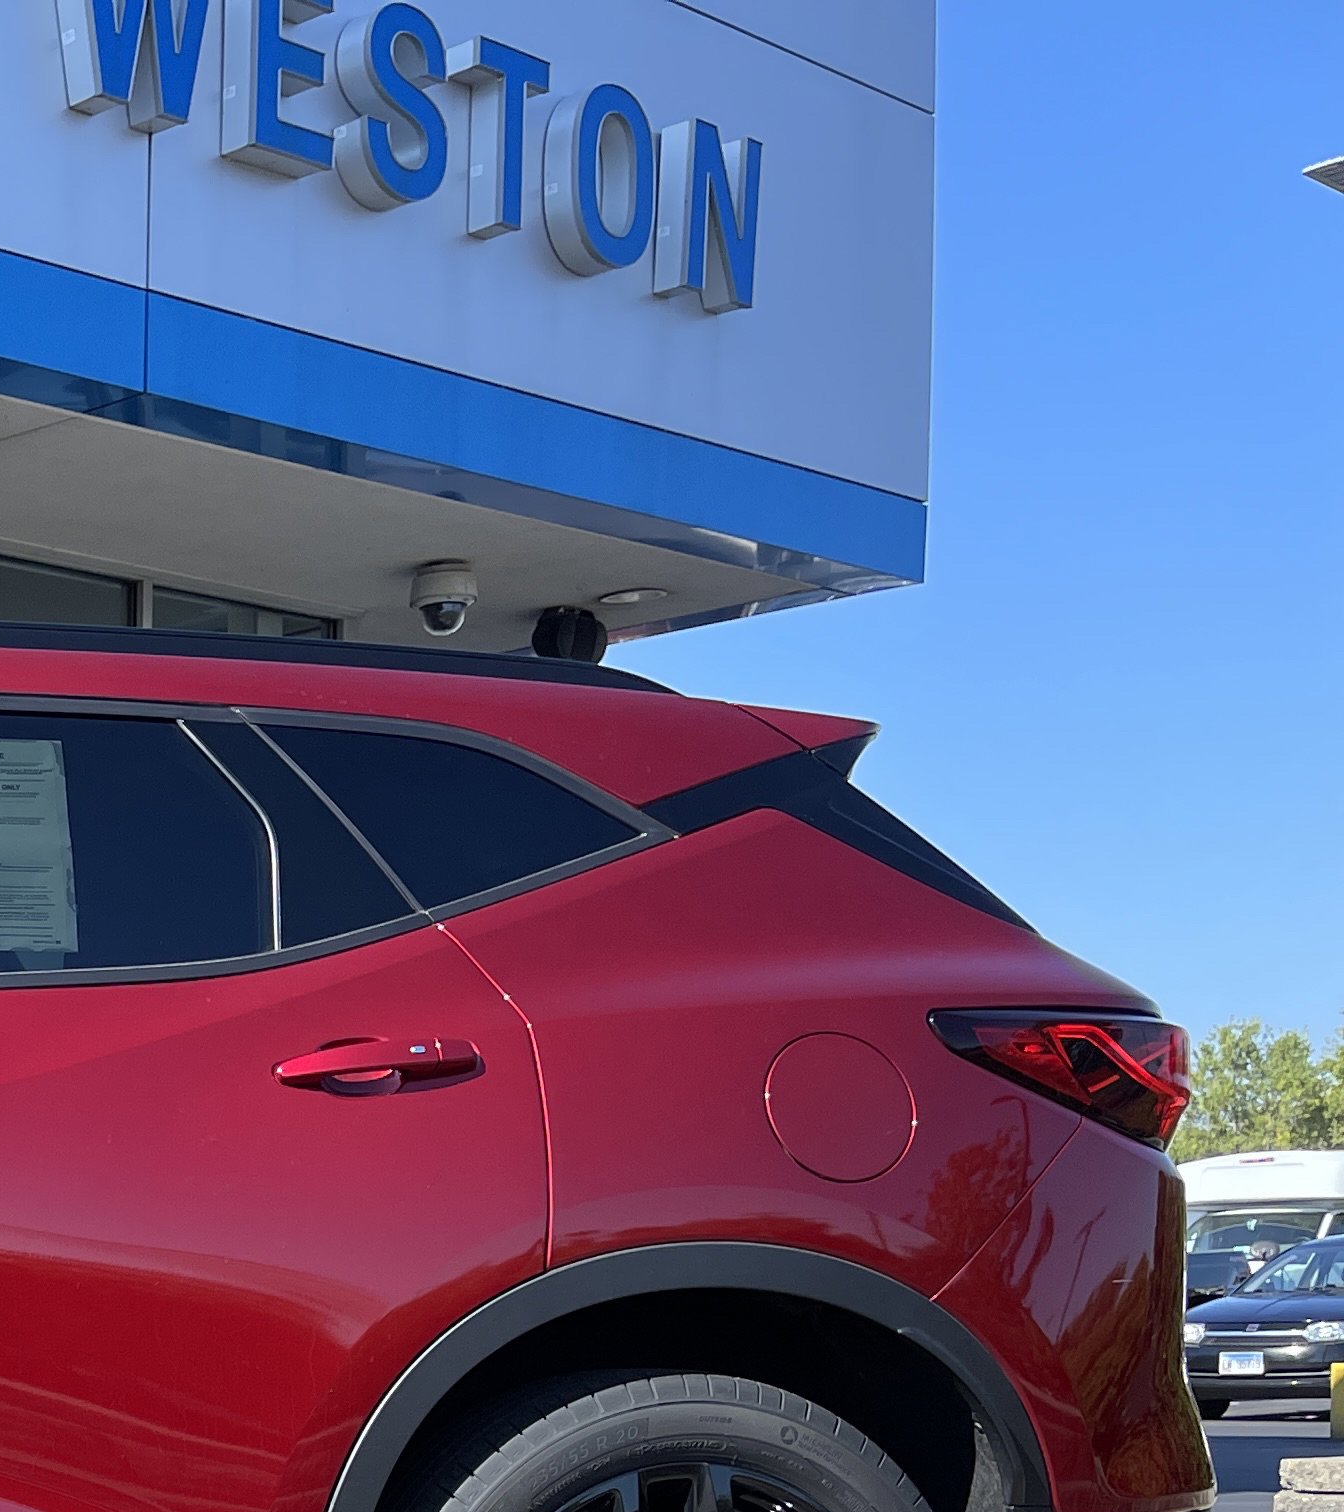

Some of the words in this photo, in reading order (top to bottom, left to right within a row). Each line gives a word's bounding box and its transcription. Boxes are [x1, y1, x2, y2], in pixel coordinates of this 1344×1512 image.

[60, 0, 764, 314] WESTON
[529, 1443, 591, 1491] 235/55
[593, 1434, 610, 1452] R
[613, 1424, 640, 1444] 20
